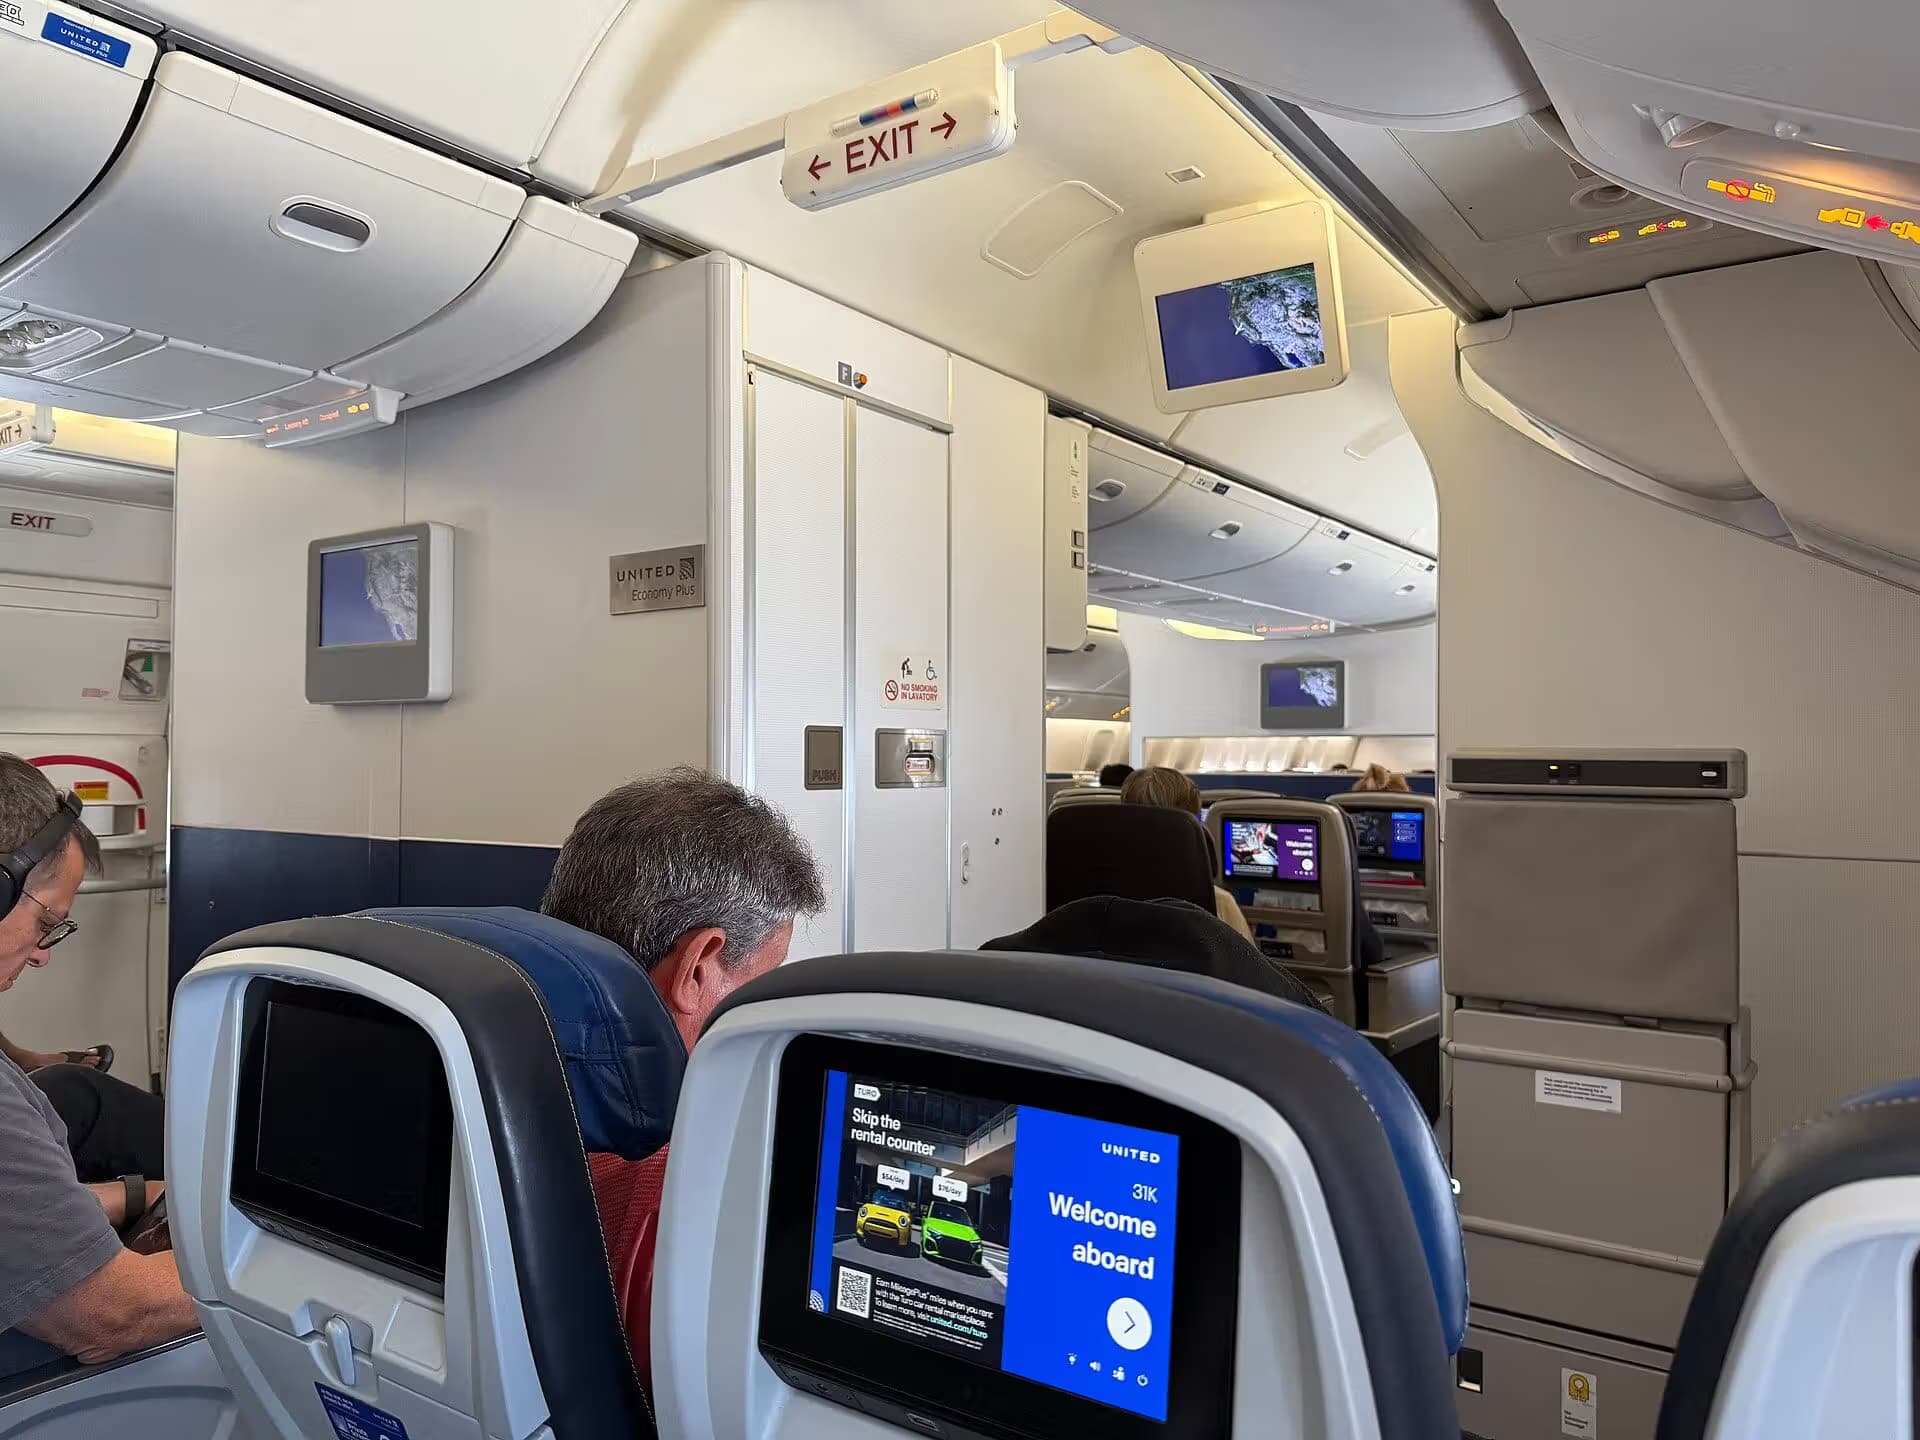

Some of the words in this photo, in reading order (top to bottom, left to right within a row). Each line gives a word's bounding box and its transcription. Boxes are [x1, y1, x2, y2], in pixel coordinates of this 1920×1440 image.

[60, 27, 99, 47] UNITED
[70, 39, 96, 55] Economy
[95, 50, 108, 58] Plus
[846, 120, 919, 174] EXIT
[10, 512, 56, 530] EXIT
[616, 565, 675, 582] UNITED
[631, 586, 674, 602] Economy
[675, 584, 695, 597] Plus
[900, 683, 910, 692] NO
[911, 683, 938, 693] SMOKING
[900, 691, 907, 700] IN
[908, 692, 938, 702] LAVATORY
[812, 769, 837, 782] PUSH
[856, 1087, 877, 1098] TURO
[852, 1107, 879, 1129] Skip
[880, 1114, 901, 1131] the
[850, 1128, 886, 1146] rental
[887, 1136, 936, 1156] counter
[1101, 1142, 1161, 1164] UNITED
[1132, 1183, 1158, 1204] 31K
[1048, 1191, 1157, 1239] Welcome
[1071, 1240, 1155, 1280] aboard
[875, 1277, 890, 1288] Earn
[930, 1294, 947, 1306] miles
[947, 1299, 966, 1311] when
[965, 1305, 978, 1315] you
[875, 1289, 889, 1299] with
[889, 1292, 900, 1302] the
[900, 1294, 914, 1306] Turo
[913, 1301, 924, 1309] car
[924, 1303, 944, 1315] rental
[874, 1297, 882, 1307] To
[882, 1299, 898, 1311] learn
[916, 1311, 930, 1322] visit
[929, 1316, 989, 1339] united.com/turo
